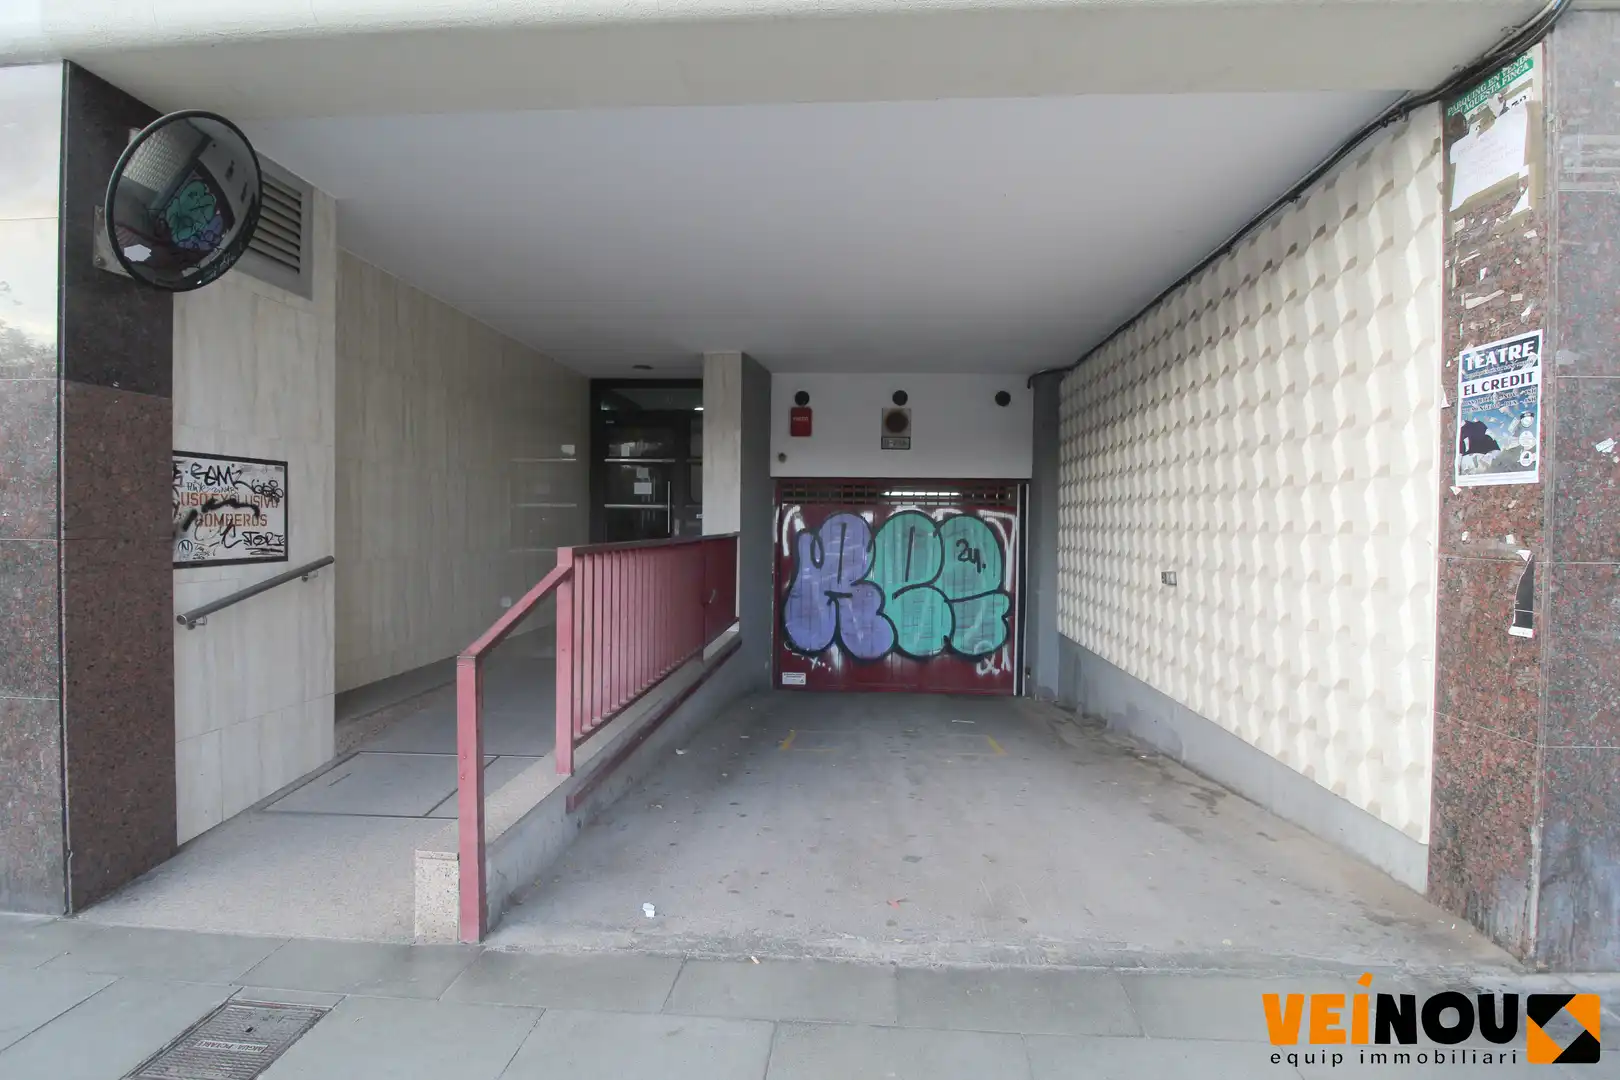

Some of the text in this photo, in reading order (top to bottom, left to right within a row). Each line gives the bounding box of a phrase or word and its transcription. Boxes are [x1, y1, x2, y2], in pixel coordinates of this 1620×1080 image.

[1465, 341, 1535, 371] TEATRE
[1464, 371, 1535, 396] EL CREDIT
[180, 491, 207, 507] USO
